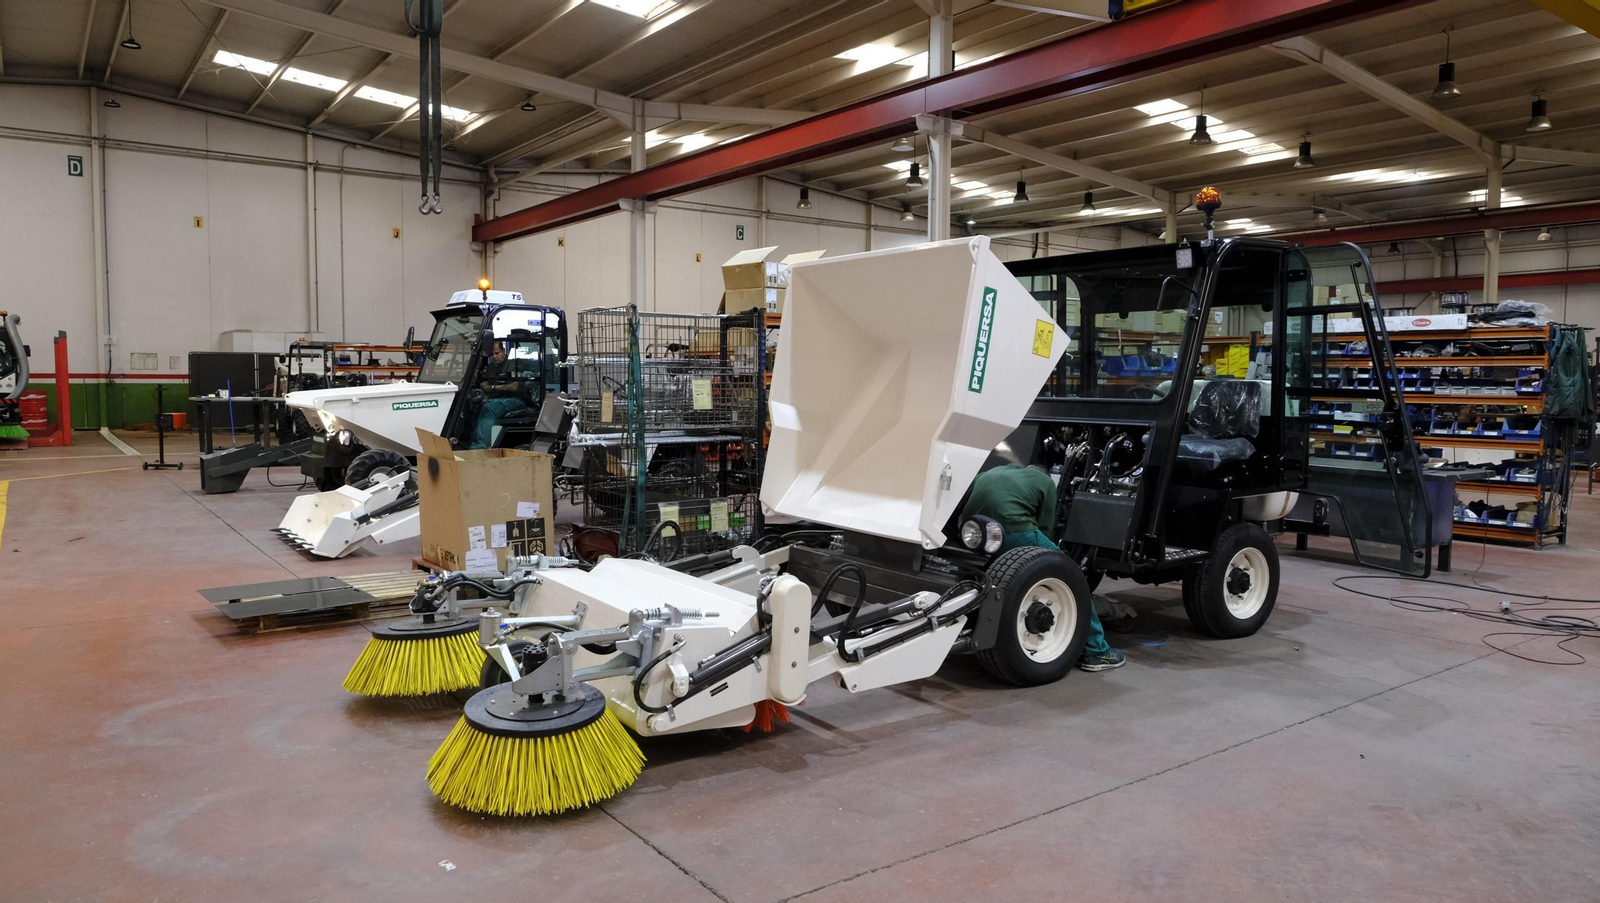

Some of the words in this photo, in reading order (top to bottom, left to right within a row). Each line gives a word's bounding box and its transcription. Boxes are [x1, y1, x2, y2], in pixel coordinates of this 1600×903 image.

[70, 160, 81, 175] D
[737, 228, 743, 239] C
[971, 292, 995, 390] PIQUERSA
[393, 401, 438, 409] PIQUERSA
